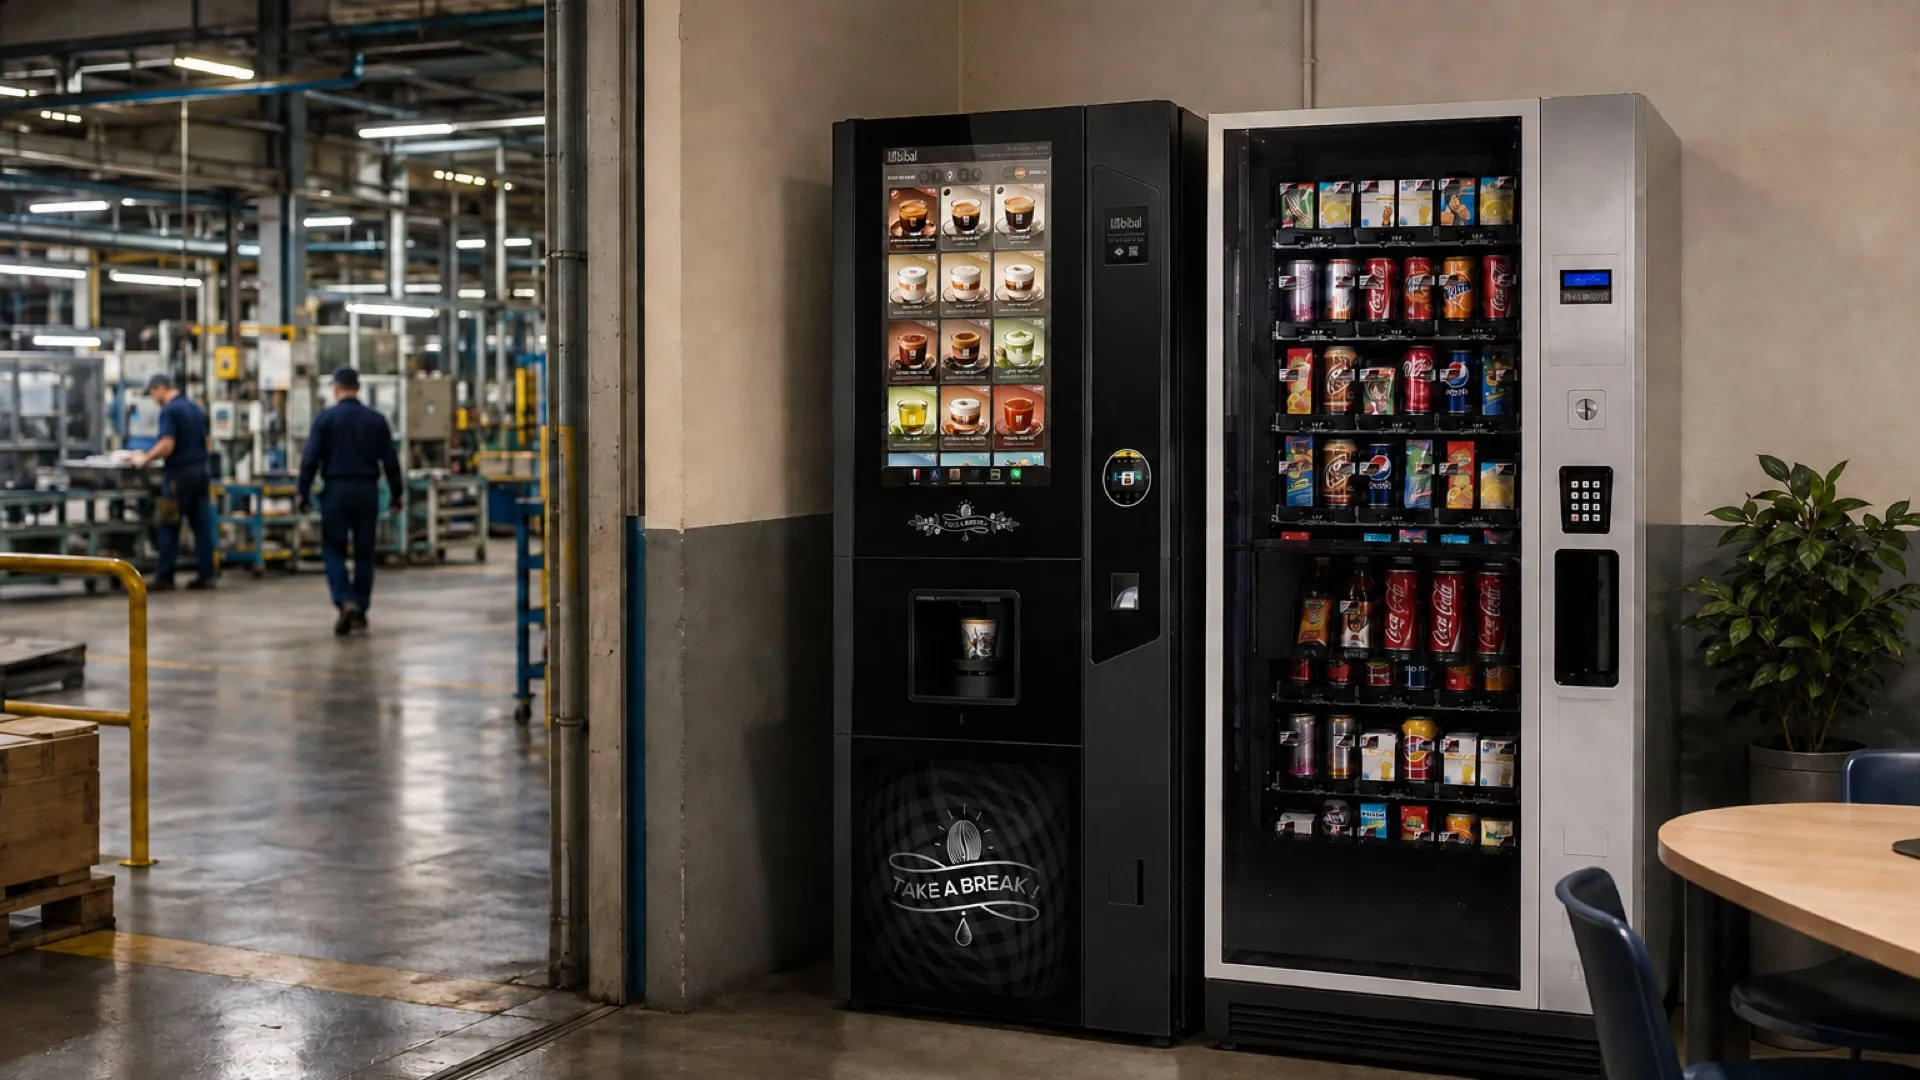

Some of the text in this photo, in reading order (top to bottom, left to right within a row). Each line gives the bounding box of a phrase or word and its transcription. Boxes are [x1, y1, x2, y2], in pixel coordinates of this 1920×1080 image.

[893, 876, 941, 900] TAKE
[944, 880, 959, 897] A
[960, 875, 1029, 896] BREAK
